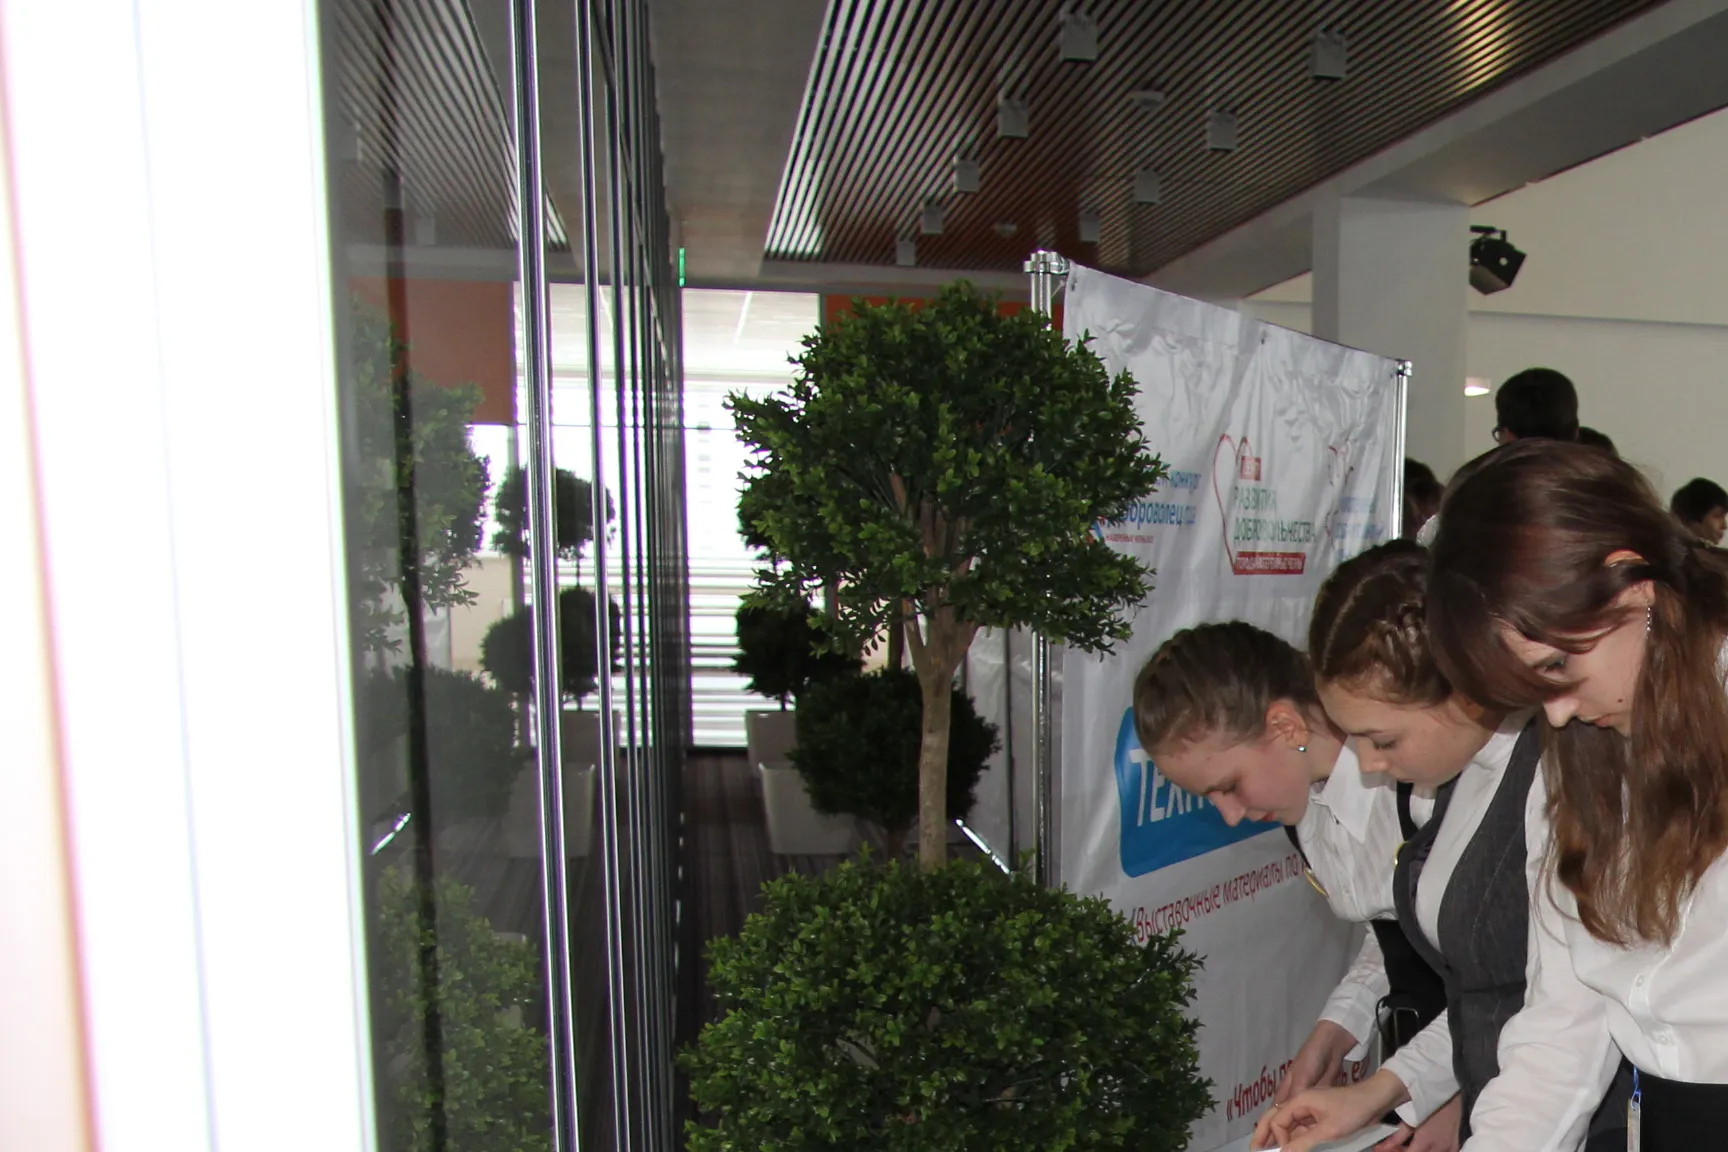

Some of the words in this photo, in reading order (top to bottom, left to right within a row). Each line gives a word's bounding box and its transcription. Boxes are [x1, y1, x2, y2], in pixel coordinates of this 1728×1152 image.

[1222, 862, 1284, 905] материалы
[1285, 854, 1300, 881] по
[1226, 1064, 1276, 1122] «Чтобы
